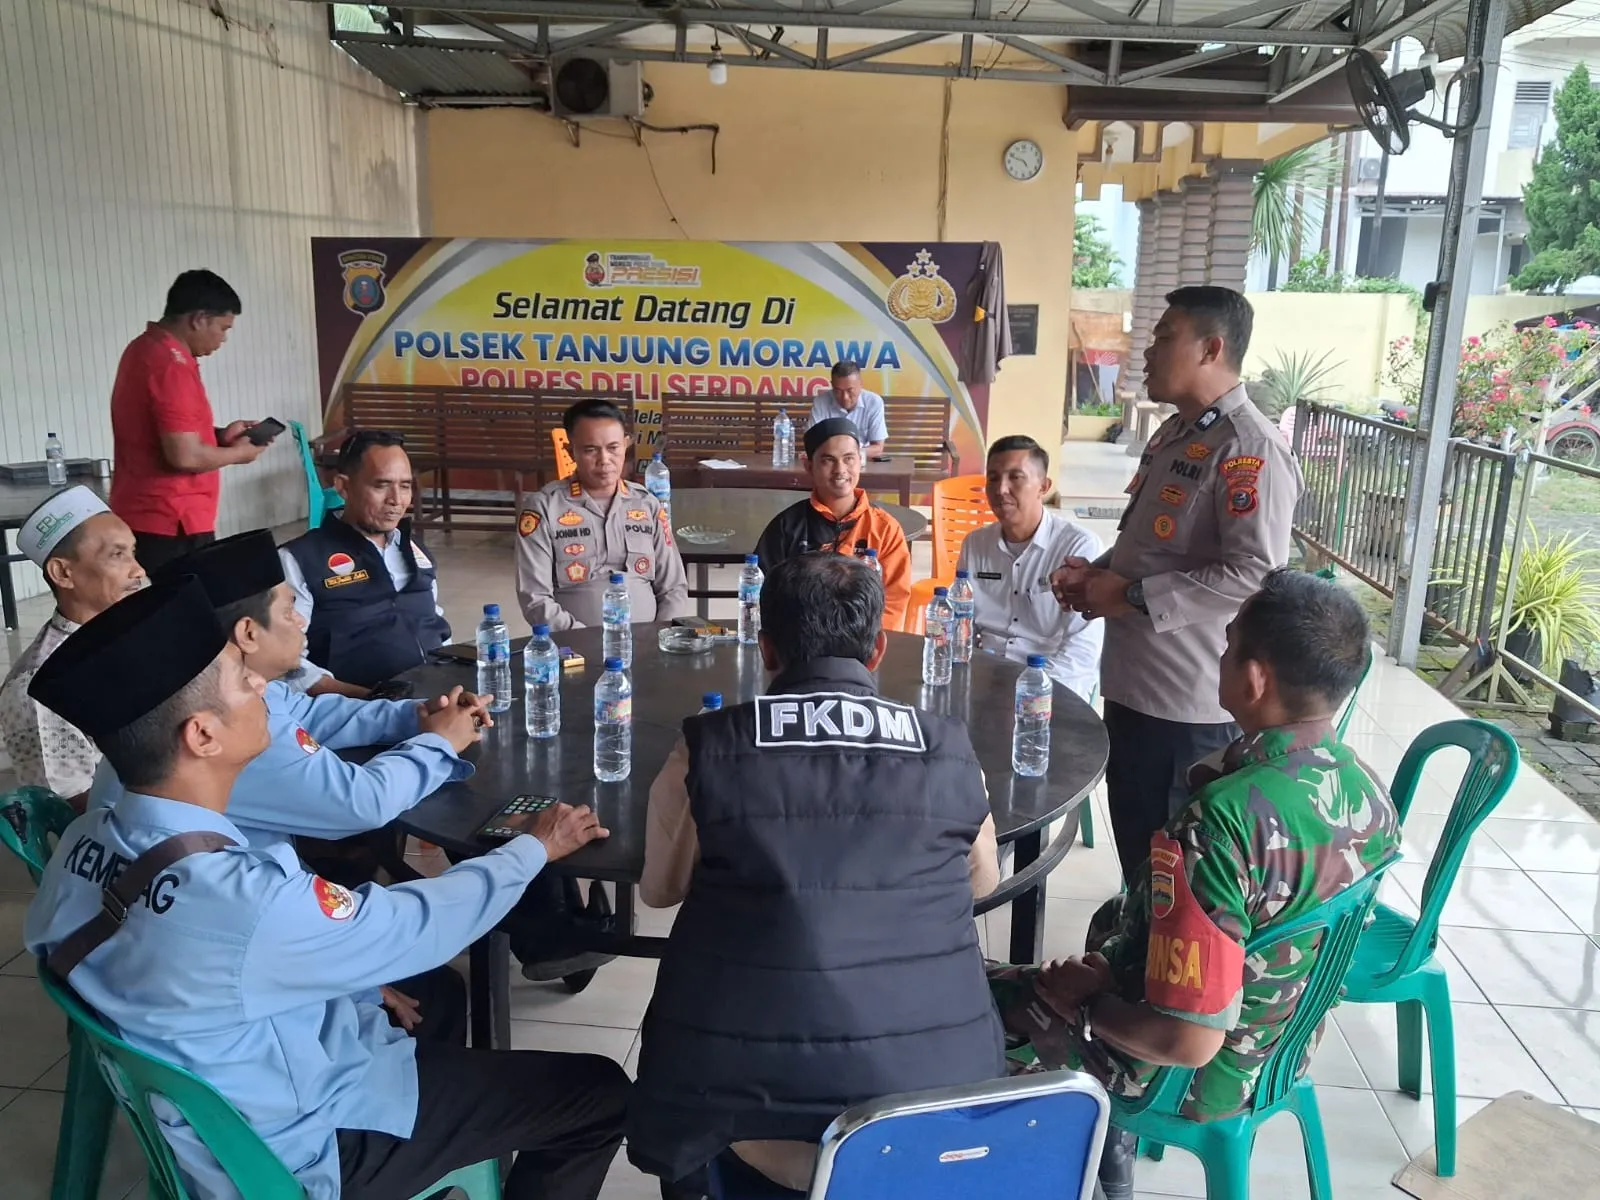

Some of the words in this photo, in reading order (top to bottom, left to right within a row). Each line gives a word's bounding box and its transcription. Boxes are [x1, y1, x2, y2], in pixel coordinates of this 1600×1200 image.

[611, 267, 698, 282] PRESISI
[493, 292, 624, 322] Selamat
[633, 294, 751, 329] Datang
[761, 296, 796, 325] Di
[394, 330, 526, 360] POLSEK
[532, 333, 712, 365] TANJUNG
[719, 338, 902, 369] MORAWA
[461, 366, 583, 391] POLRES
[591, 372, 659, 400] DELI
[1170, 459, 1203, 481] POLRI
[1223, 457, 1262, 470] POLRESTA
[625, 524, 653, 535] POLRI
[770, 700, 916, 742] FKDM
